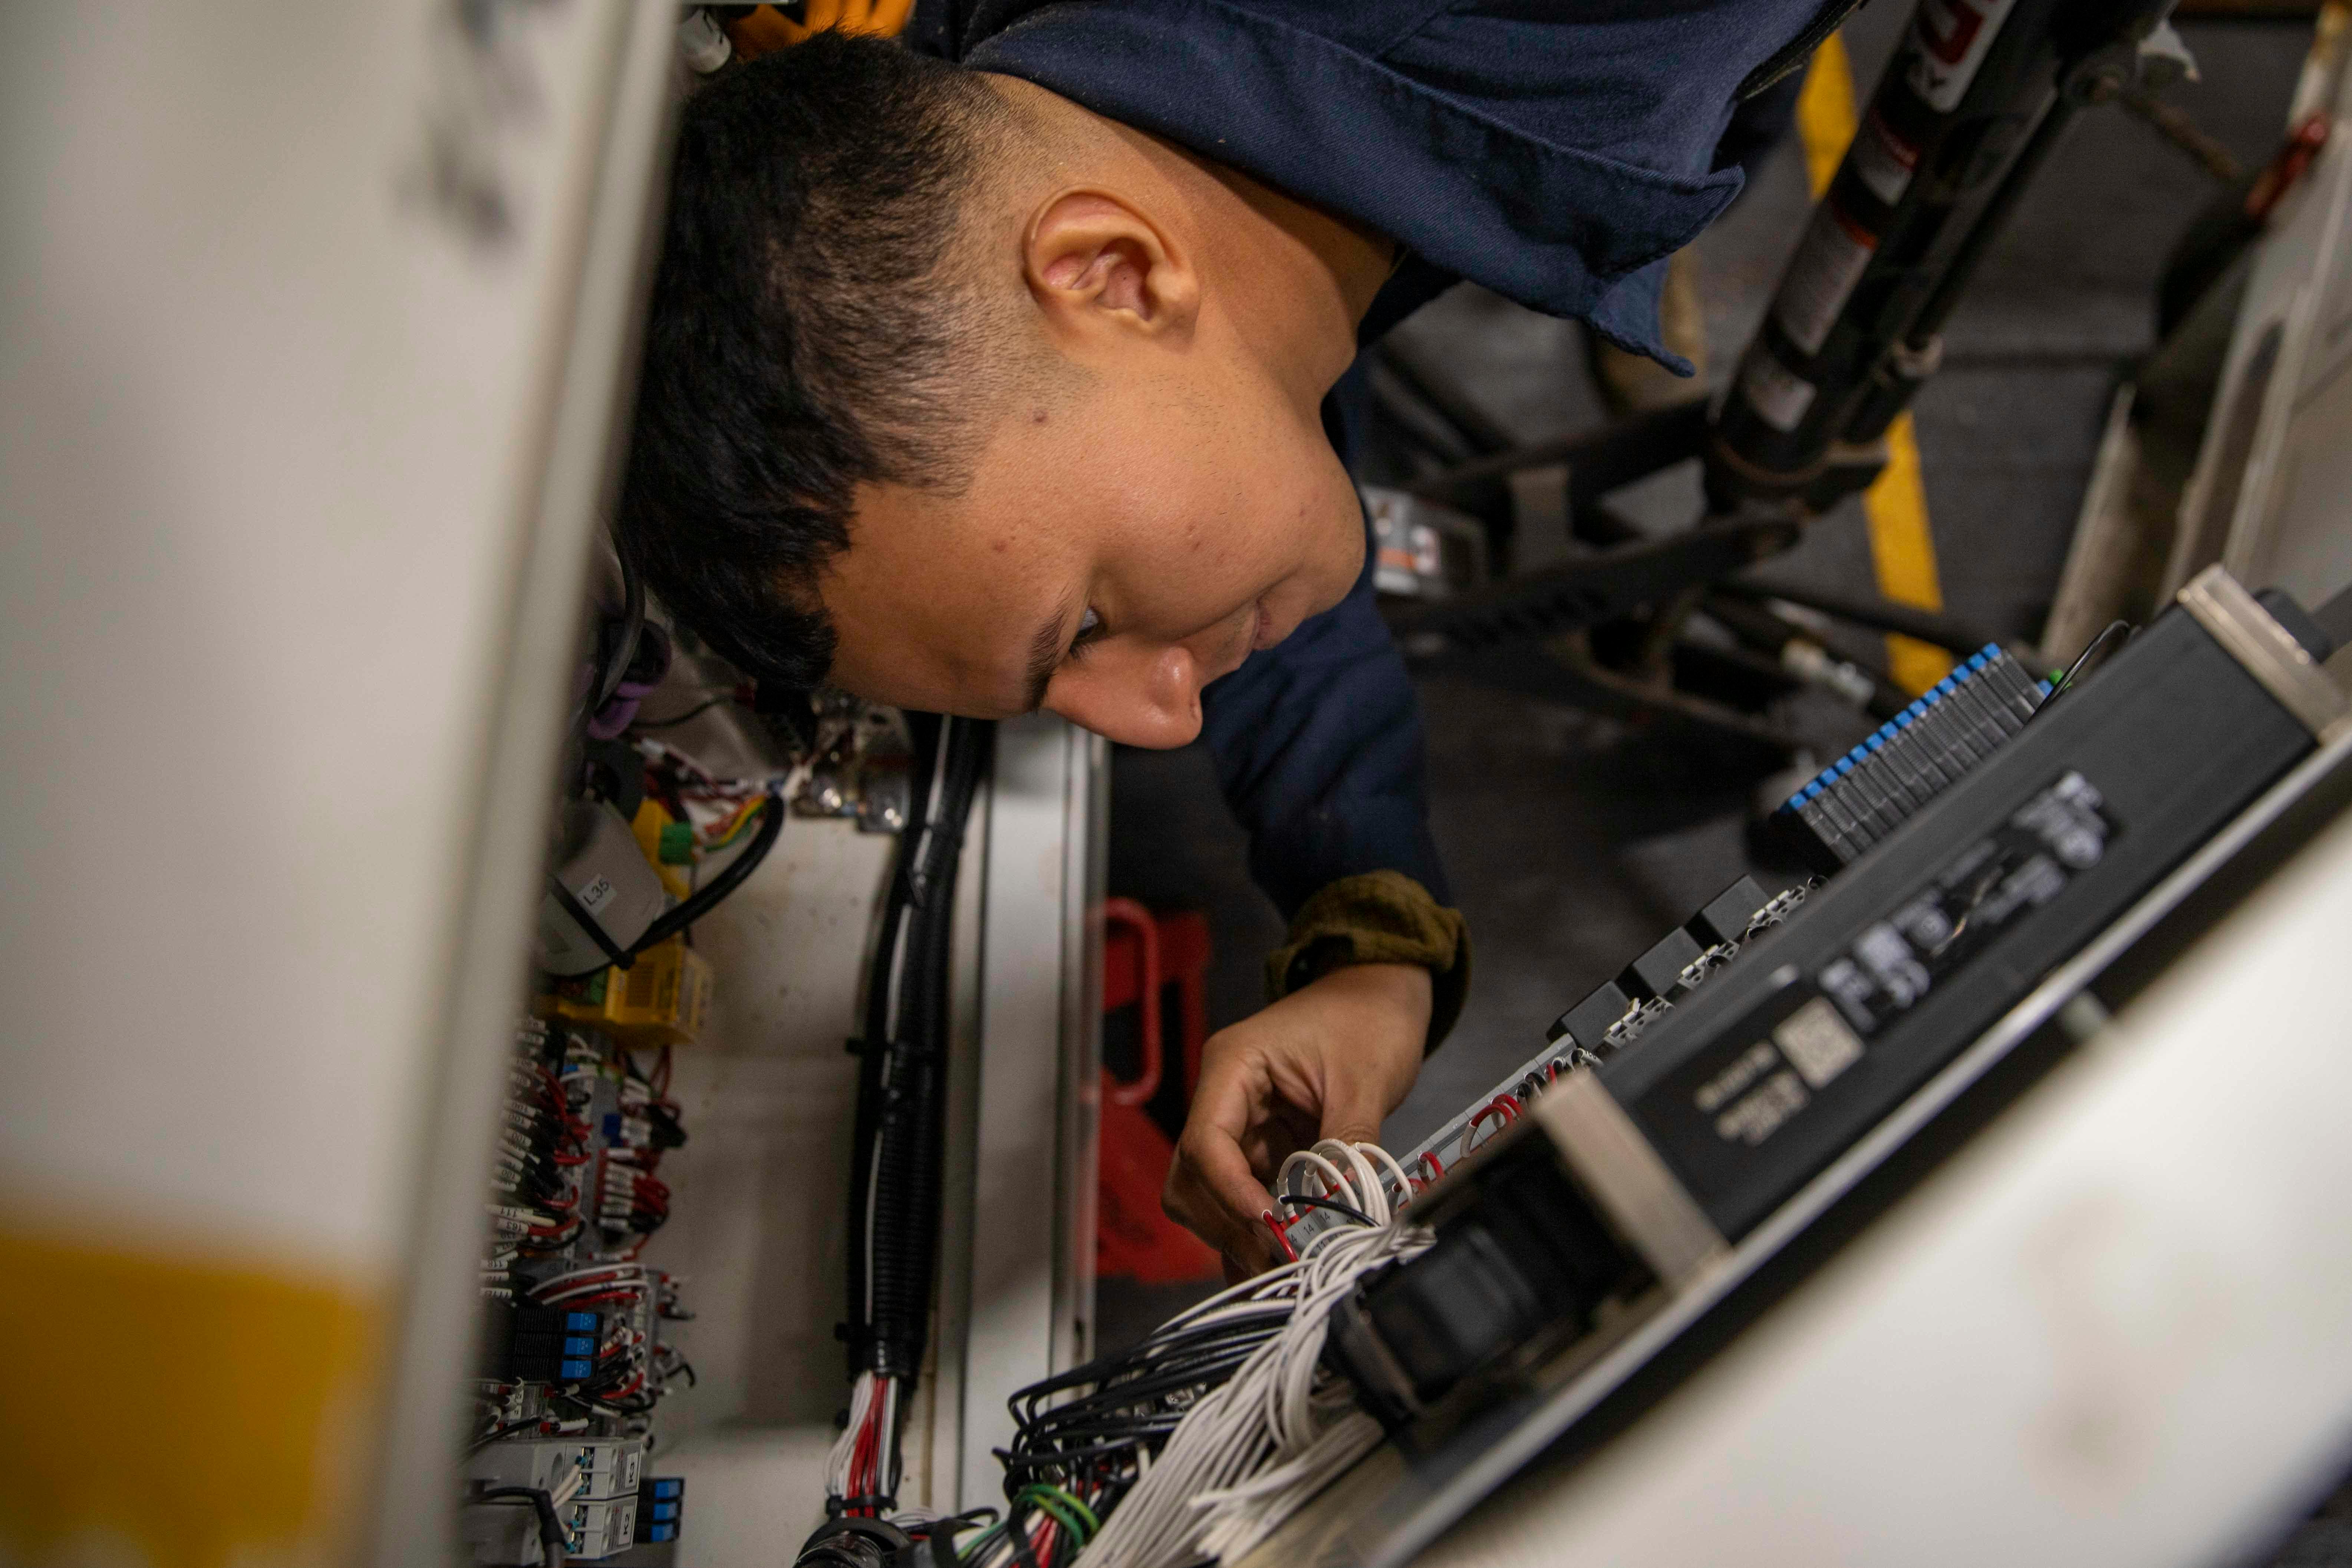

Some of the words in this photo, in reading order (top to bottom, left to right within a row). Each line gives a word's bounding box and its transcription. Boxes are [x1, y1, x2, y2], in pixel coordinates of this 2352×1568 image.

[501, 1208, 517, 1218] 111
[1320, 1211, 1331, 1223] 14
[506, 1222, 522, 1232] 163
[1303, 1223, 1314, 1235] 14
[628, 1462, 635, 1483] K3
[623, 1513, 630, 1535] K2
